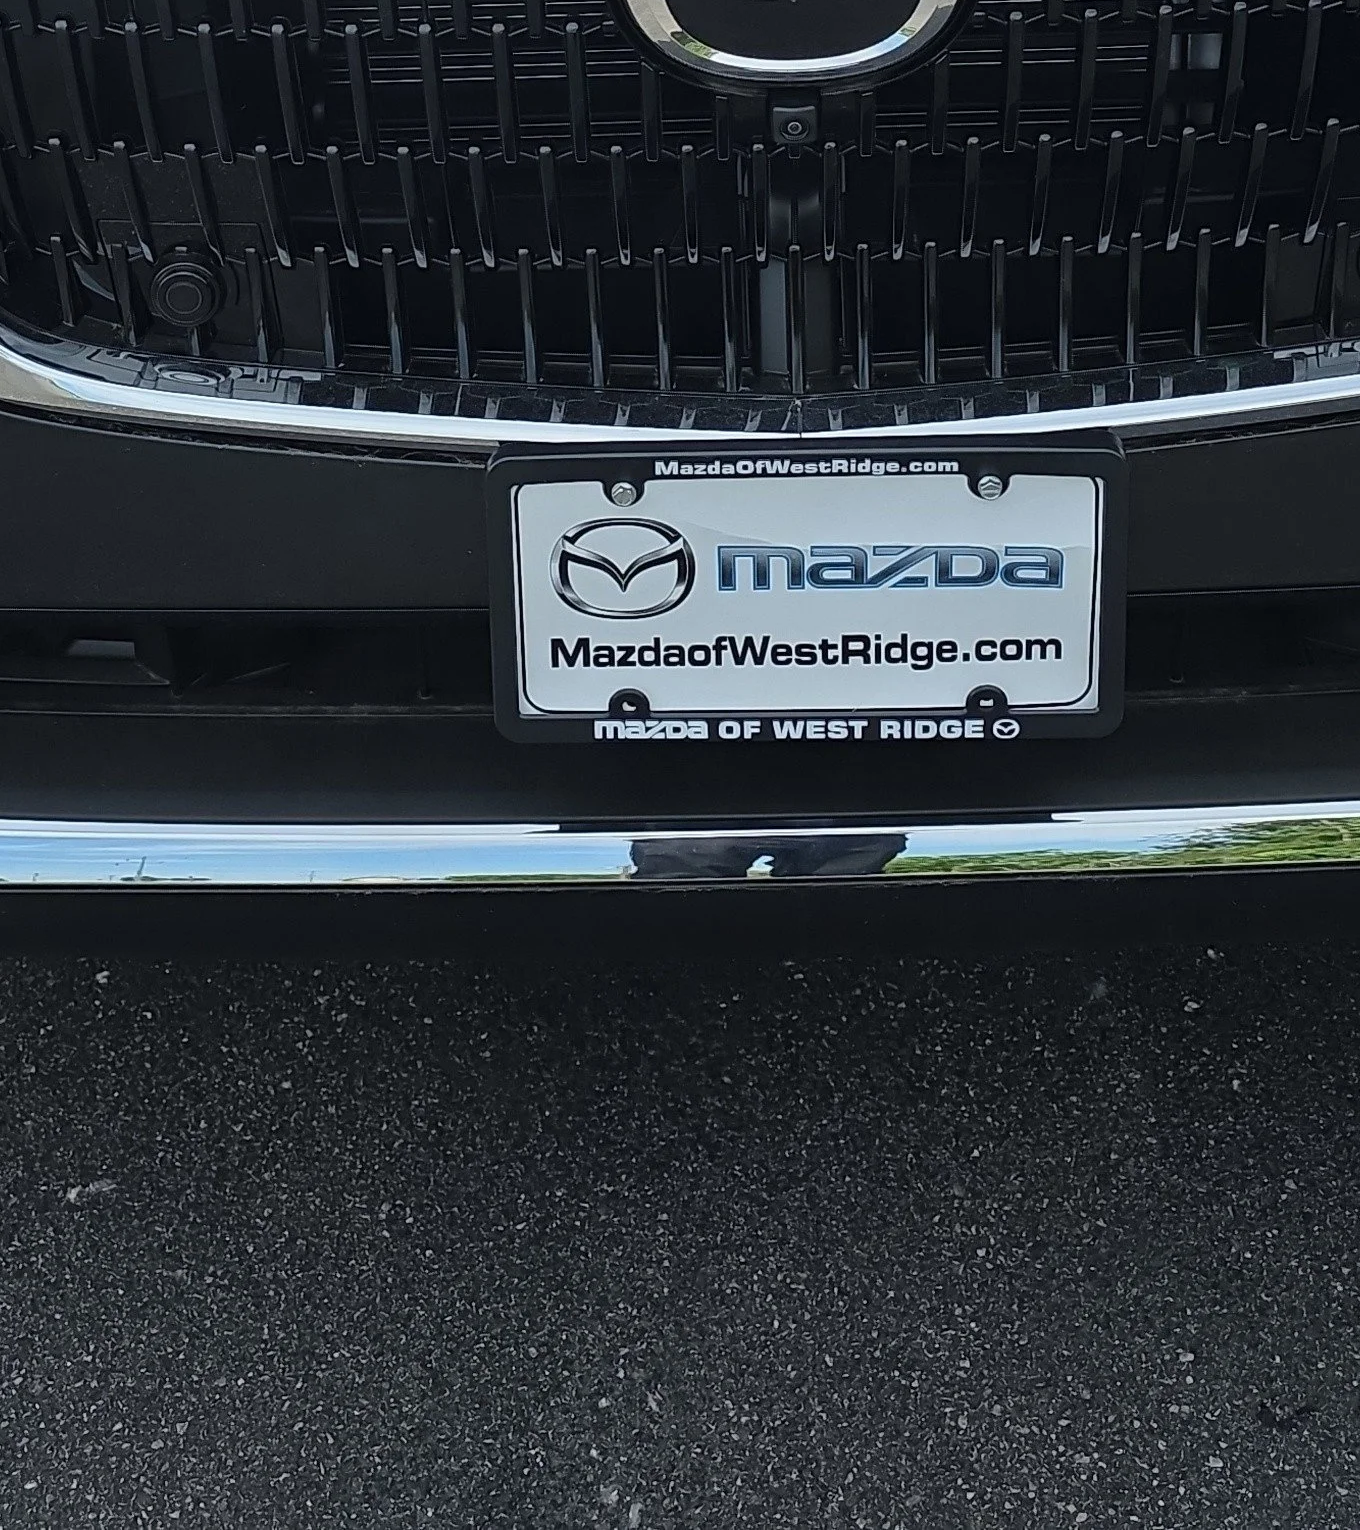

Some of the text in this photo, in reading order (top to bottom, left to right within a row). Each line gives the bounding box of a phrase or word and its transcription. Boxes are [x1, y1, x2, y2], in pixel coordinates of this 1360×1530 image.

[654, 458, 960, 476] MazdaOfWestRidge.com
[716, 544, 1065, 592] mazda
[549, 634, 1064, 671] MazdaofWestRidge.com
[593, 719, 985, 741] mazda OF WEST RIDGE
